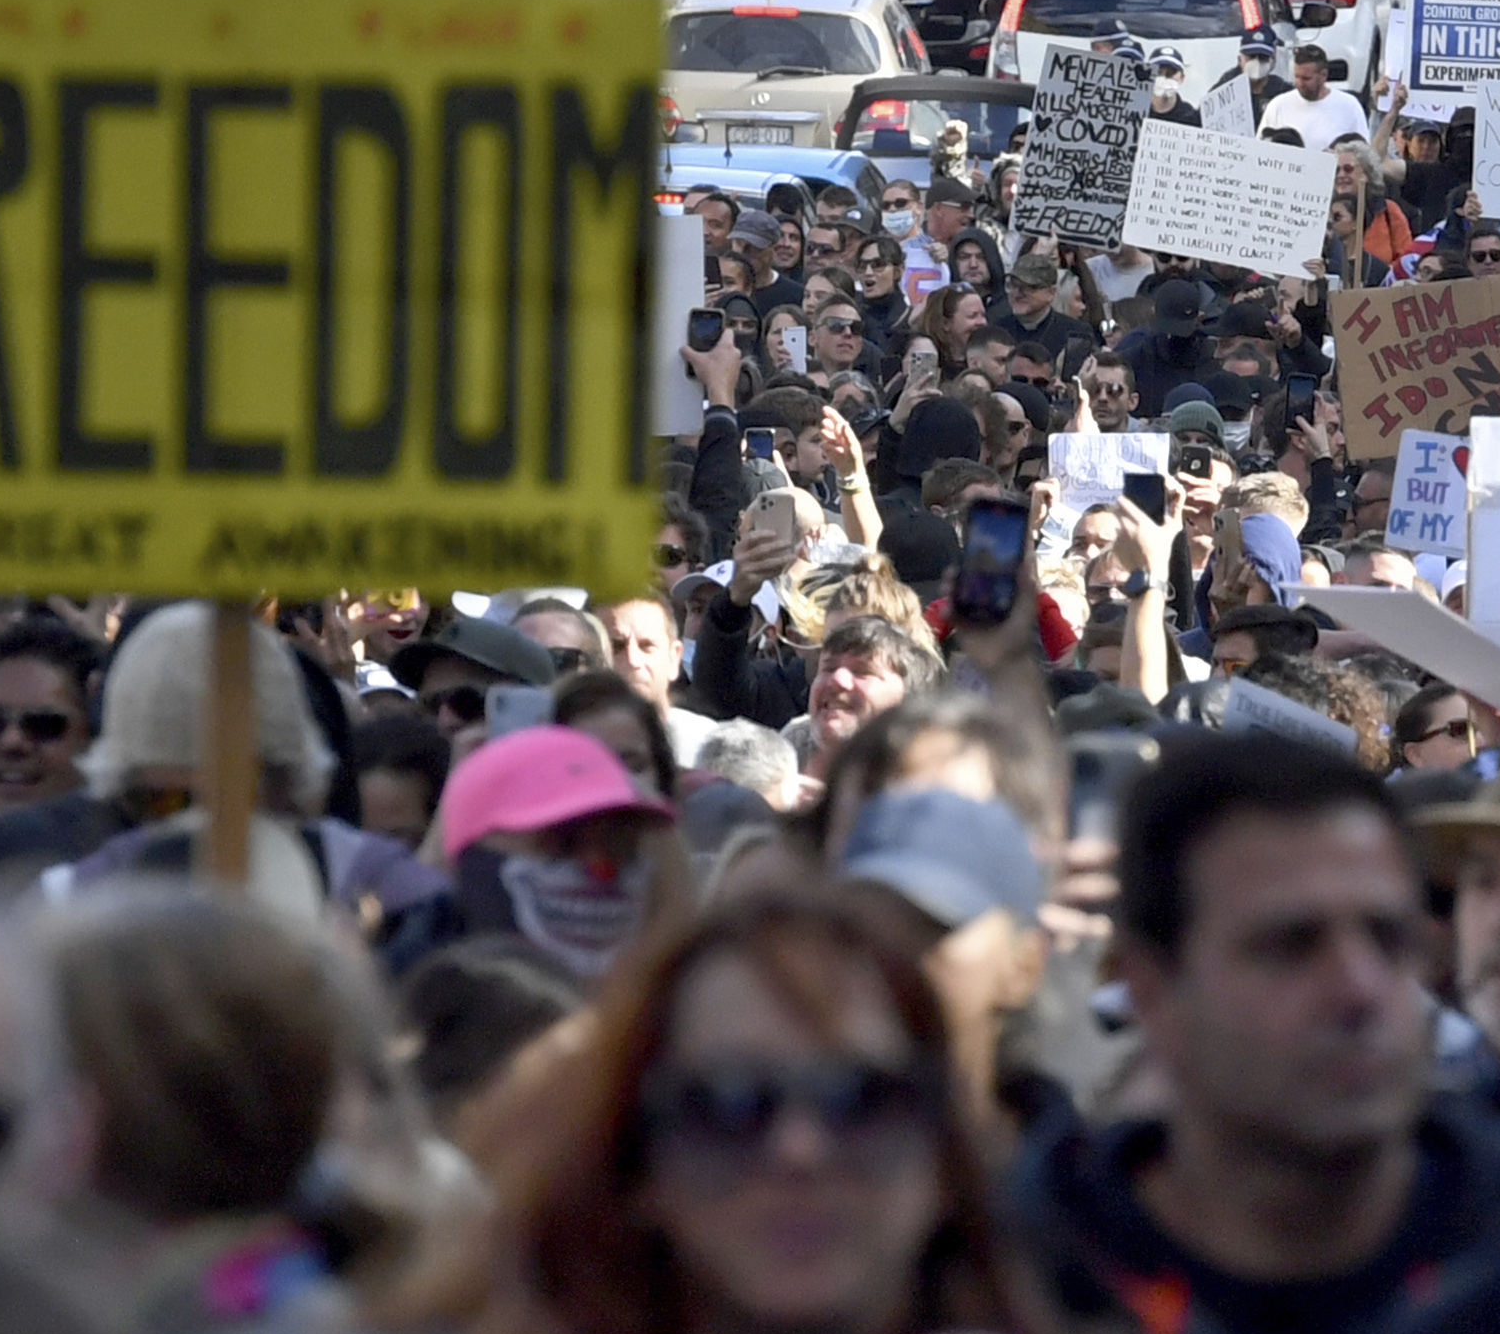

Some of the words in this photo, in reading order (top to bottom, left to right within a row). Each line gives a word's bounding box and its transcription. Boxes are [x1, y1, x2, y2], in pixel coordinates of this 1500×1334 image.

[1423, 4, 1472, 20] CONTROL
[1421, 25, 1447, 55] IN
[1049, 52, 1136, 90] MENTAL
[1036, 91, 1075, 115] KILLS
[1074, 83, 1133, 105] HEALTH
[1203, 99, 1214, 118] DO
[1217, 83, 1236, 108] NOT
[1056, 118, 1128, 147] COVID
[1144, 123, 1190, 141] RIDDLE
[1197, 132, 1213, 143] ME
[1160, 140, 1178, 151] THE
[1258, 157, 1283, 171] WHY
[1024, 162, 1073, 180] COVID
[1016, 204, 1124, 237] #FREEDOM
[1157, 233, 1176, 246] NO
[1181, 236, 1233, 255] LIABILITY
[1343, 298, 1381, 344] I
[1393, 286, 1457, 338] AM
[1362, 393, 1403, 439] I
[1395, 377, 1448, 415] DO
[1415, 441, 1438, 474] I
[1407, 478, 1449, 505] BUT
[1390, 509, 1415, 537] OF
[1419, 512, 1454, 542] MY
